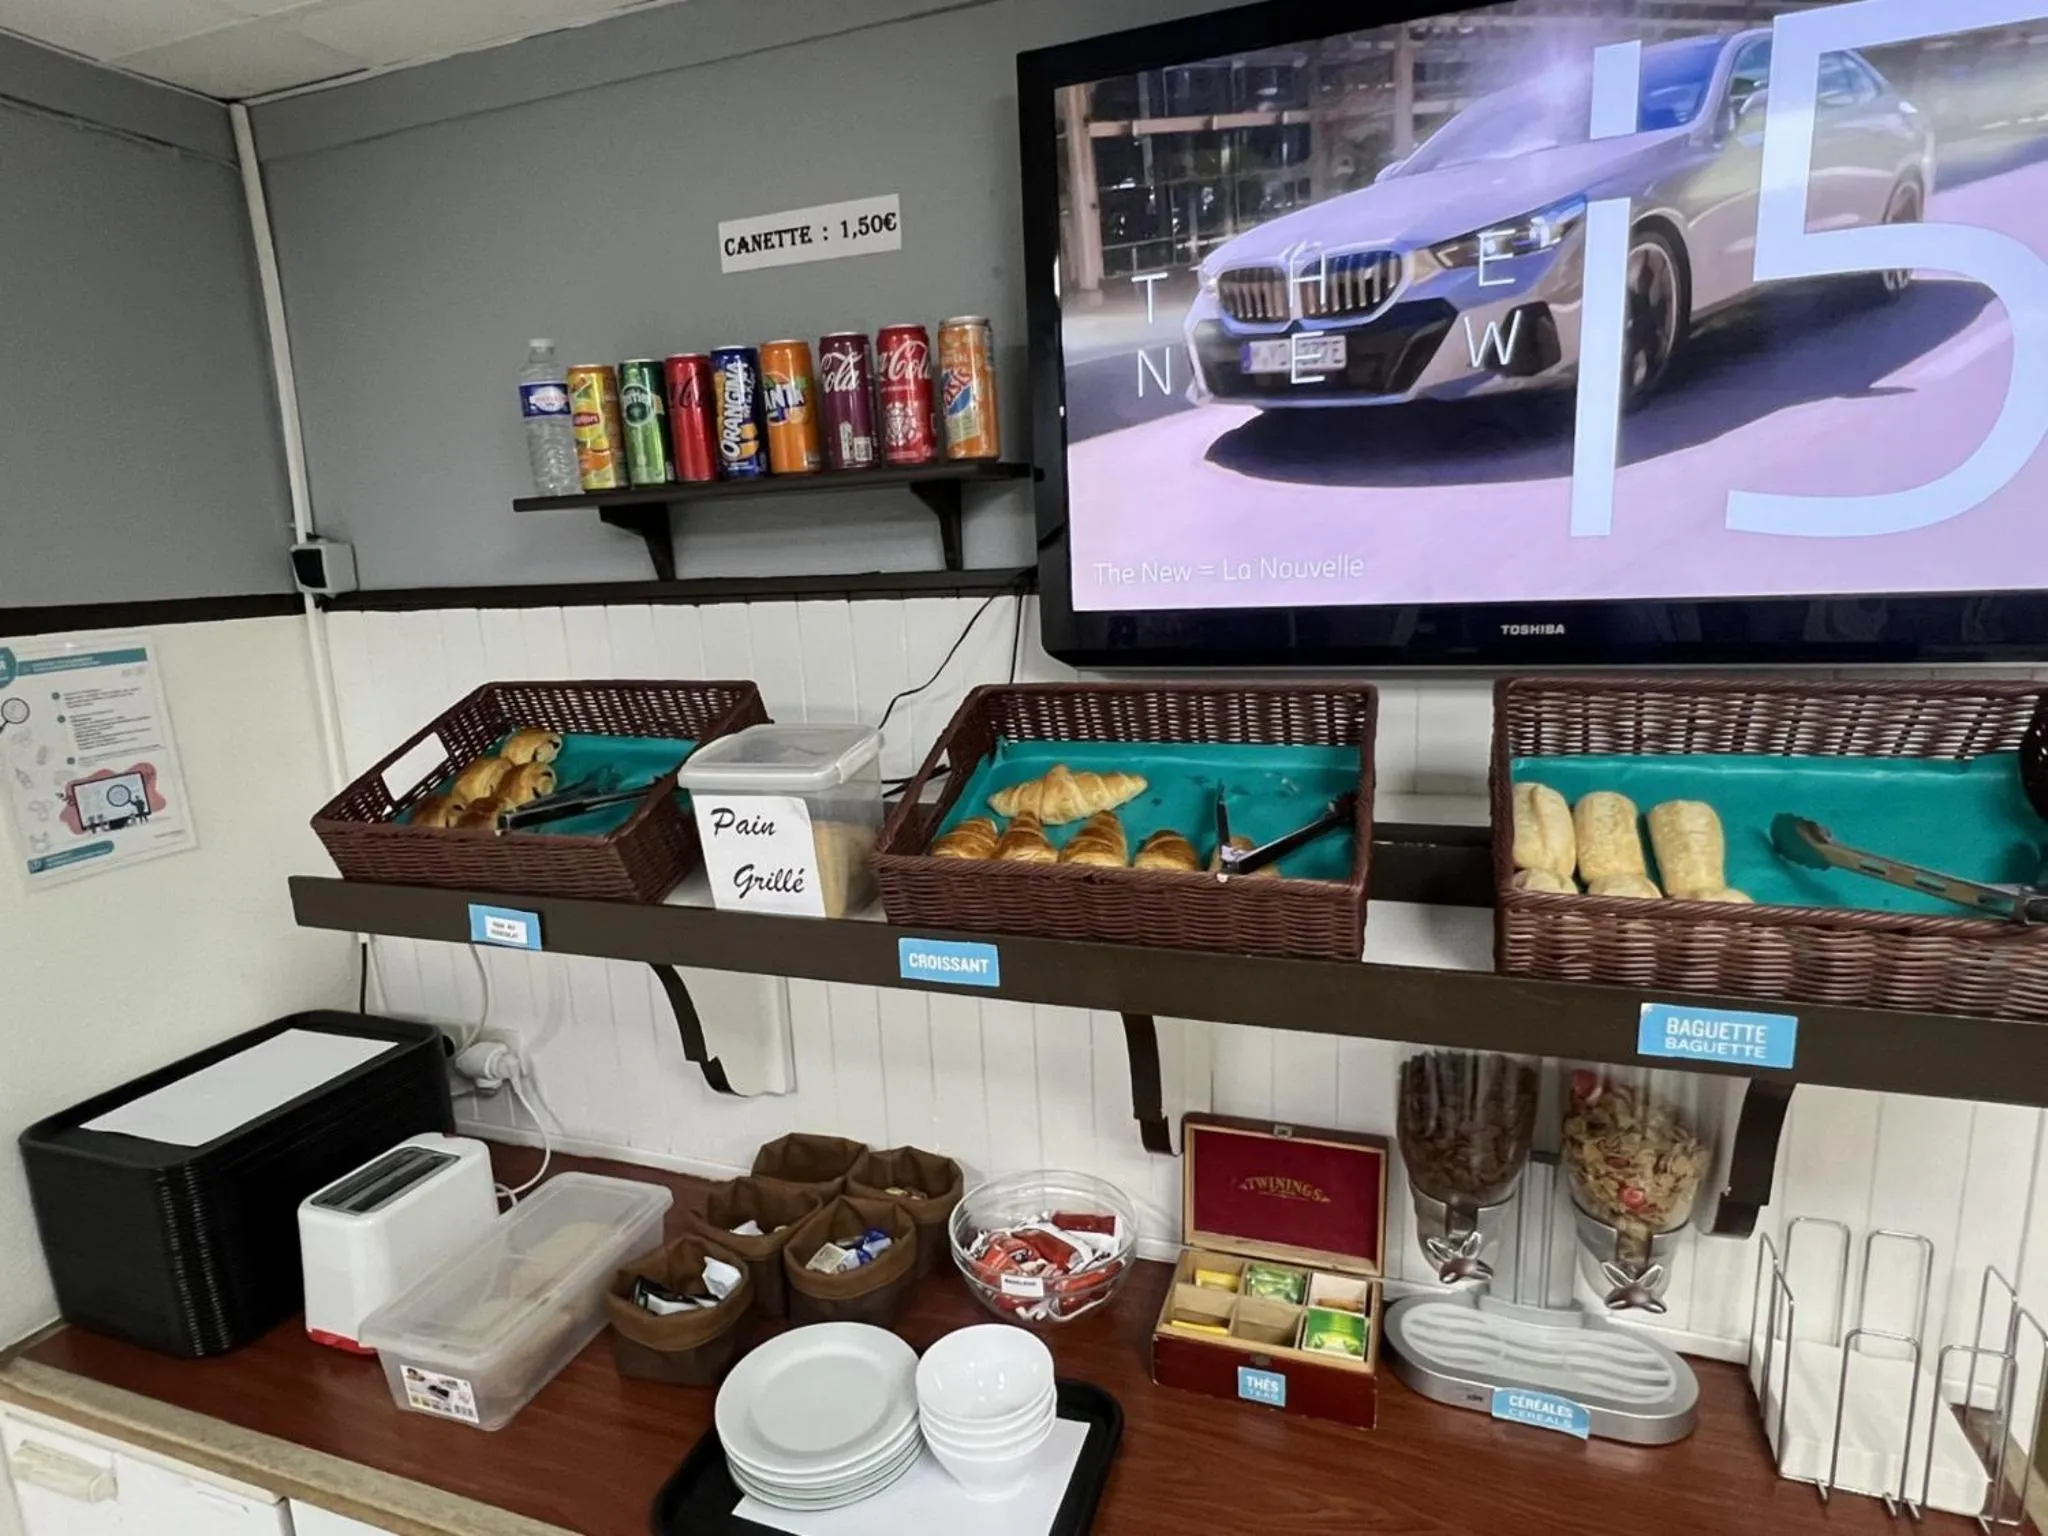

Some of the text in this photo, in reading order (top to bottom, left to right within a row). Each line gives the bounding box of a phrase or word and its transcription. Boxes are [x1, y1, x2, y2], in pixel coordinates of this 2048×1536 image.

[724, 212, 897, 257] CANETTE : 1,50€
[721, 361, 747, 460] ORANGINA
[1093, 563, 1135, 586] The
[1142, 562, 1191, 583] New
[1223, 560, 1250, 581] La
[1260, 555, 1364, 580] Nouvelle
[1500, 624, 1565, 636] TOSHIBA
[710, 807, 777, 837] Pain
[733, 864, 805, 899] Grillé
[909, 952, 989, 974] CROISSANT
[1666, 1017, 1768, 1044] BAGUETTE
[1664, 1037, 1767, 1059] BAGUETTE
[1244, 1176, 1322, 1202] TWININGS
[1509, 1394, 1574, 1418] CÉRÉALES
